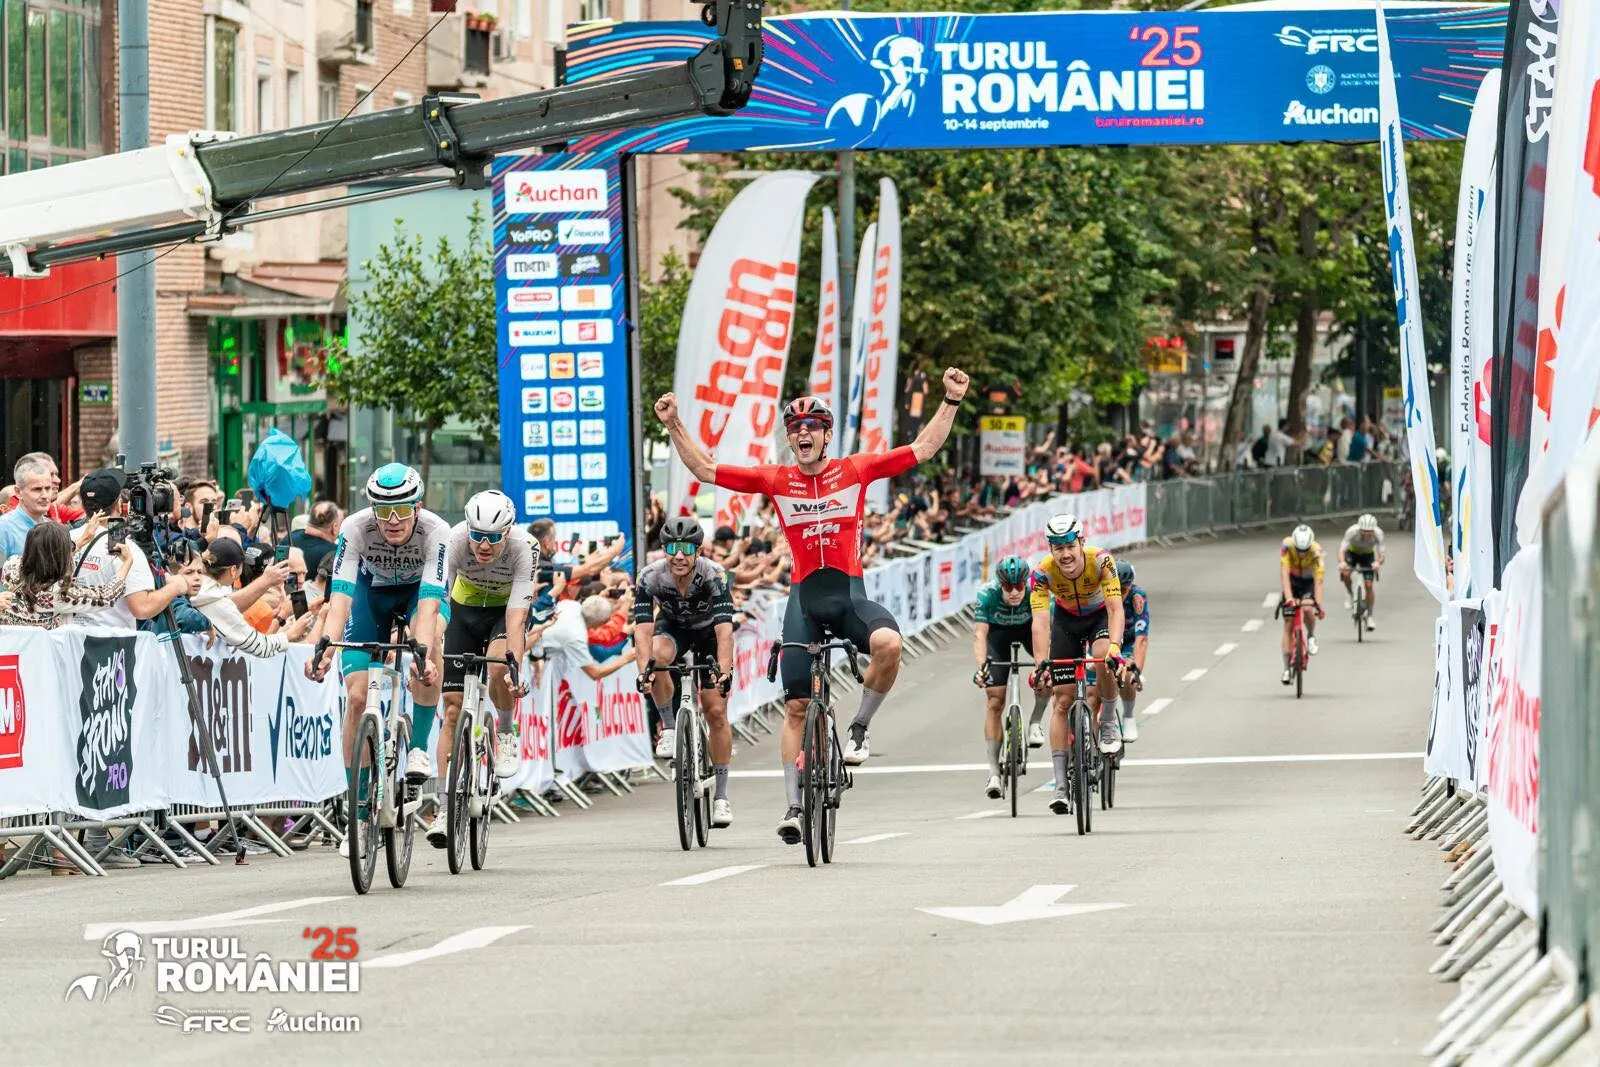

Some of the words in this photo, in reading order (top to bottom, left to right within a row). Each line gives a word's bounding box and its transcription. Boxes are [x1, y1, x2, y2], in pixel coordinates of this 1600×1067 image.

[934, 41, 1057, 71] TURUL
[1306, 34, 1378, 55] FRC
[942, 60, 1205, 114] ROMÂNIEI
[1095, 115, 1205, 128] turulromaniei.ro
[1283, 100, 1379, 124] Auchan
[943, 119, 978, 131] 10-14
[980, 119, 1049, 132] septembrie
[516, 182, 598, 203] Auchan
[286, 696, 333, 760] Rexona
[105, 762, 128, 792] PRO
